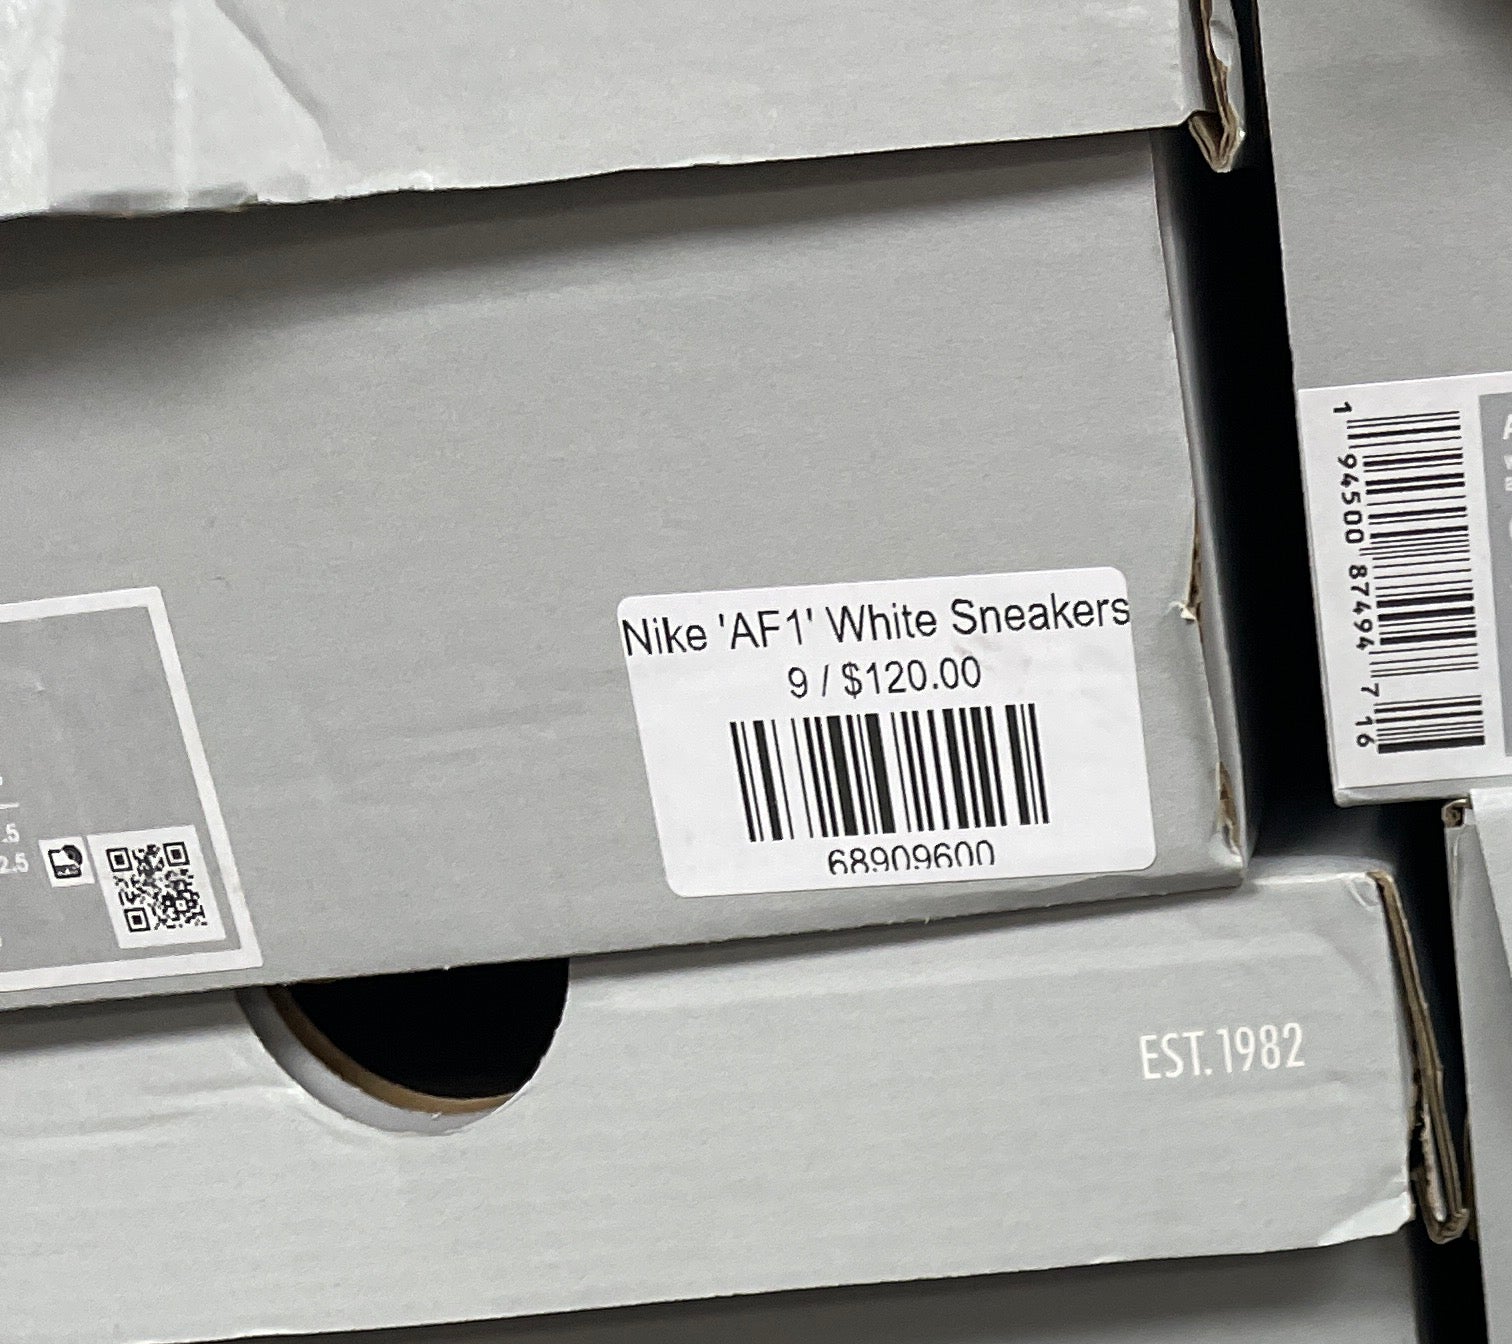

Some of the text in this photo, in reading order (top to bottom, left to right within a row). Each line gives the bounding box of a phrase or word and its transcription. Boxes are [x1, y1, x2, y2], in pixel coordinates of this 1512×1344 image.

[1337, 452, 1365, 545] 94500
[621, 592, 1131, 658] Nike 'AF1' White Sneakers
[1348, 563, 1375, 652] 87494
[787, 655, 982, 699] 9 / $120.00
